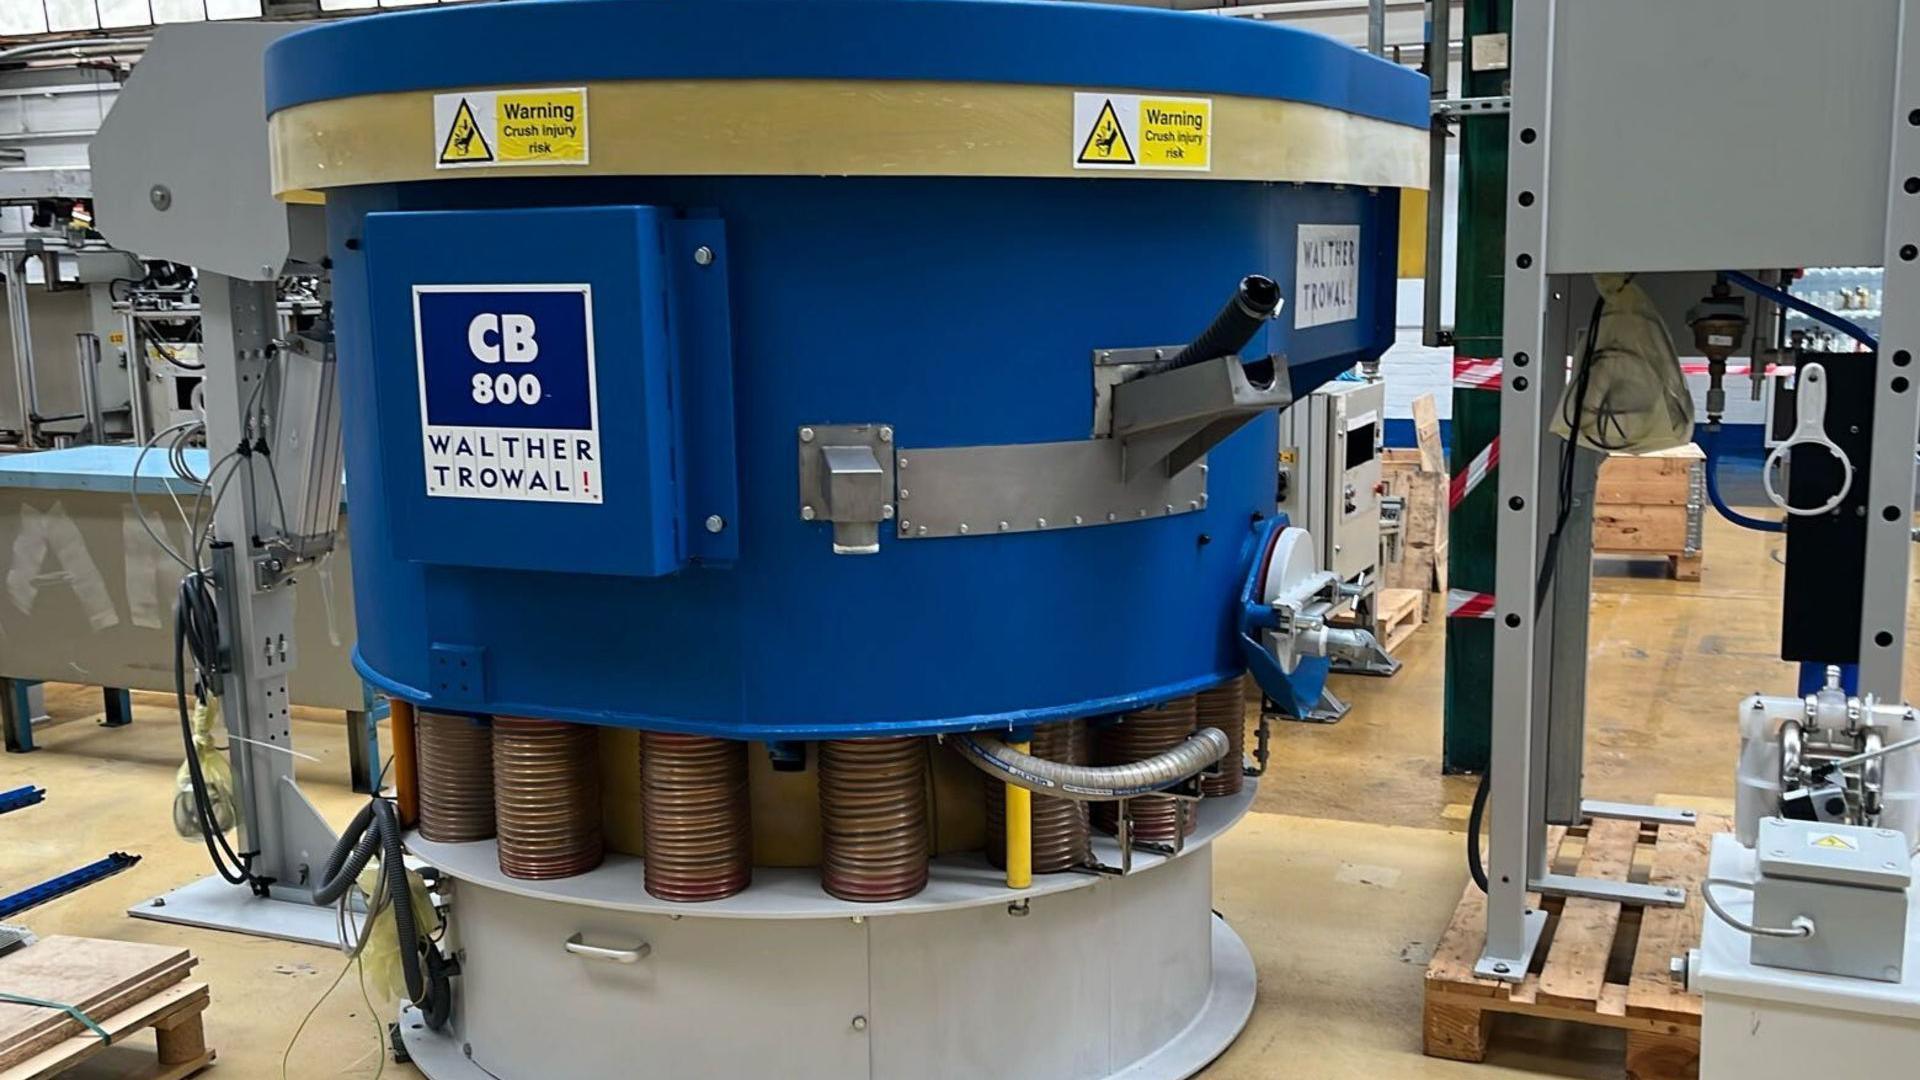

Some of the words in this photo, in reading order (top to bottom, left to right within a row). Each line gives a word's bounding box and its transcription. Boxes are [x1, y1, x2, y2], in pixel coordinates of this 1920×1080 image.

[503, 102, 575, 122] Warning
[1146, 105, 1203, 131] Warning
[503, 124, 539, 138] Crush
[541, 124, 577, 139] injury
[1145, 129, 1176, 142] Crush
[1177, 130, 1203, 146] injury
[528, 141, 552, 155] risk
[1166, 147, 1185, 158] risk
[1303, 240, 1355, 268] WALTHER
[468, 312, 539, 364] CB
[472, 372, 542, 405] 800
[428, 434, 593, 461] WALTHER
